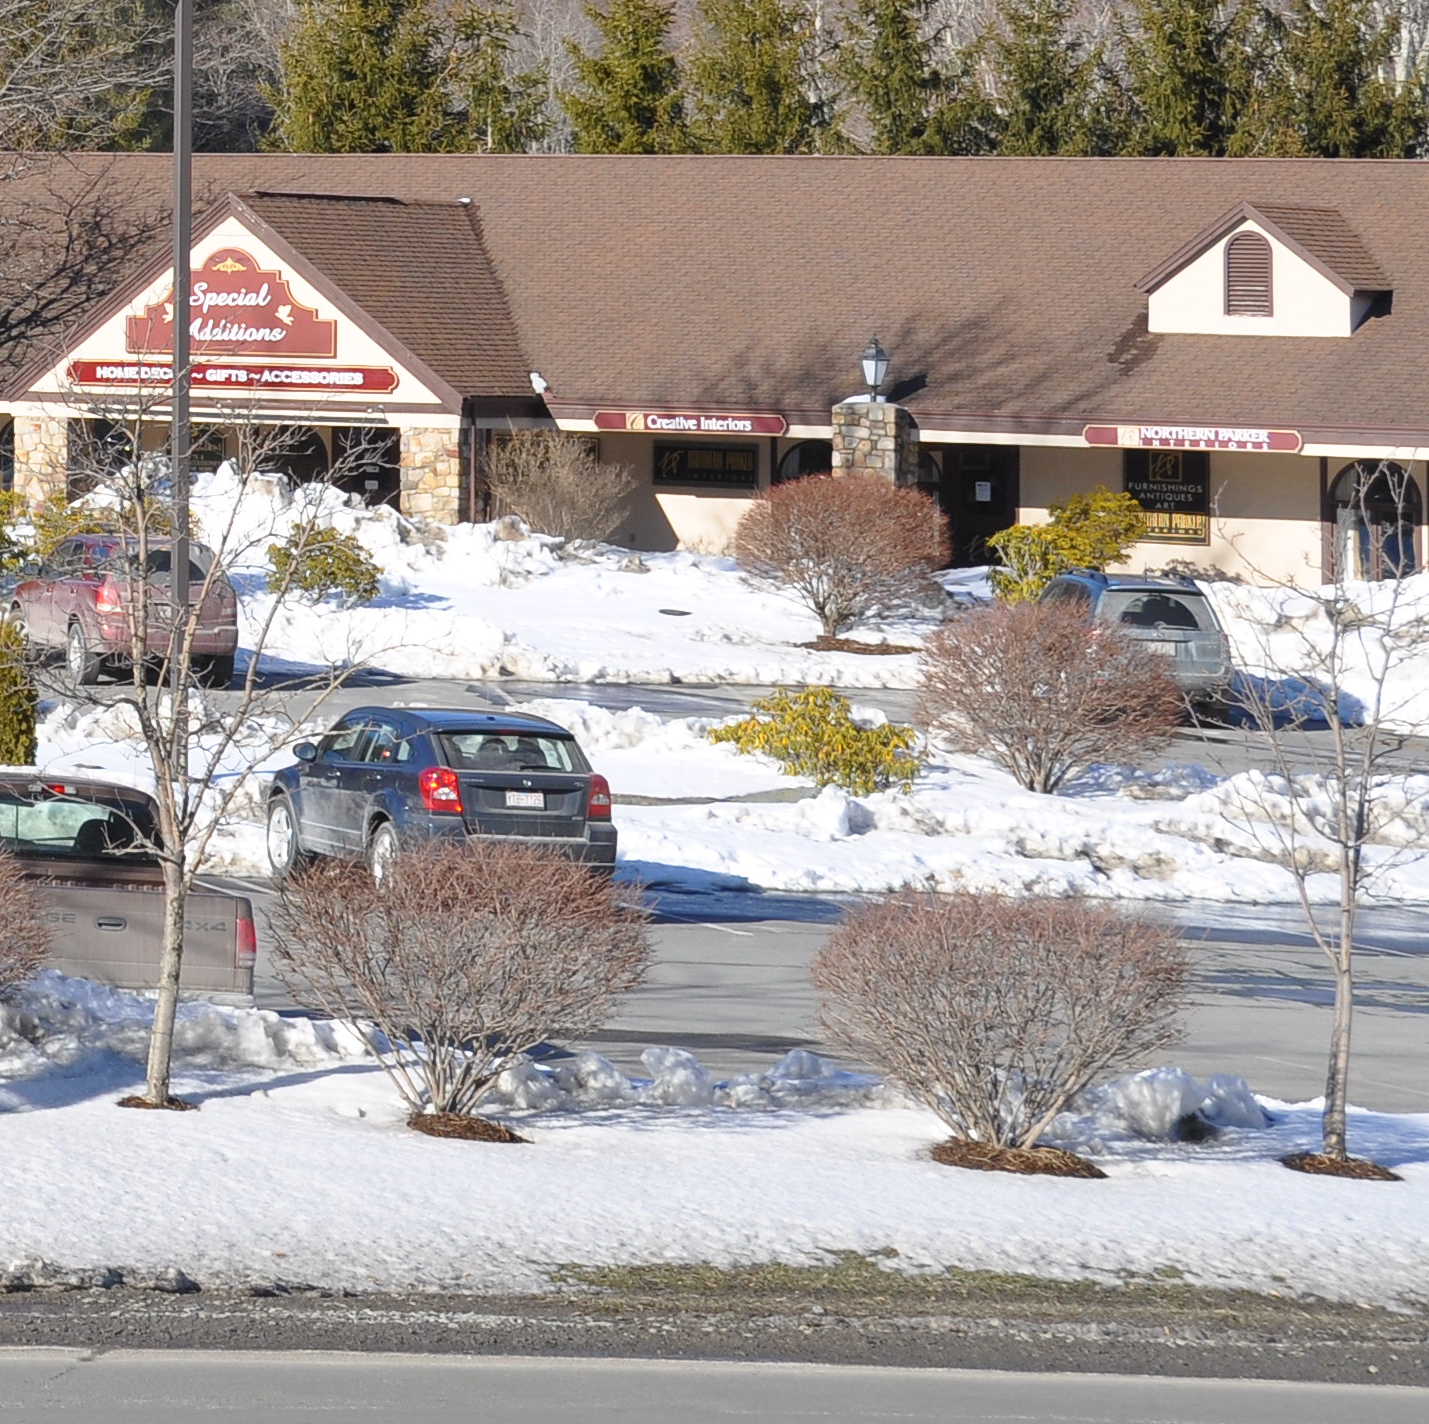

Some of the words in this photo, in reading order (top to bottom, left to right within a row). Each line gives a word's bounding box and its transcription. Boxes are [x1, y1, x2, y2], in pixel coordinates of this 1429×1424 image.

[189, 282, 272, 314] Special
[188, 317, 287, 342] Additions
[140, 367, 174, 380] DEC
[205, 369, 248, 382] GIFTS
[260, 370, 364, 385] ACCESSORIES
[647, 415, 697, 430] Creative
[700, 416, 752, 432] Interiors
[1140, 427, 1216, 441] NORTHERN
[1218, 429, 1270, 443] PARKER
[1139, 439, 1269, 450] INTERIORS
[1128, 482, 1203, 493] FURNISHINGS
[1139, 492, 1193, 502] ANTIQUES
